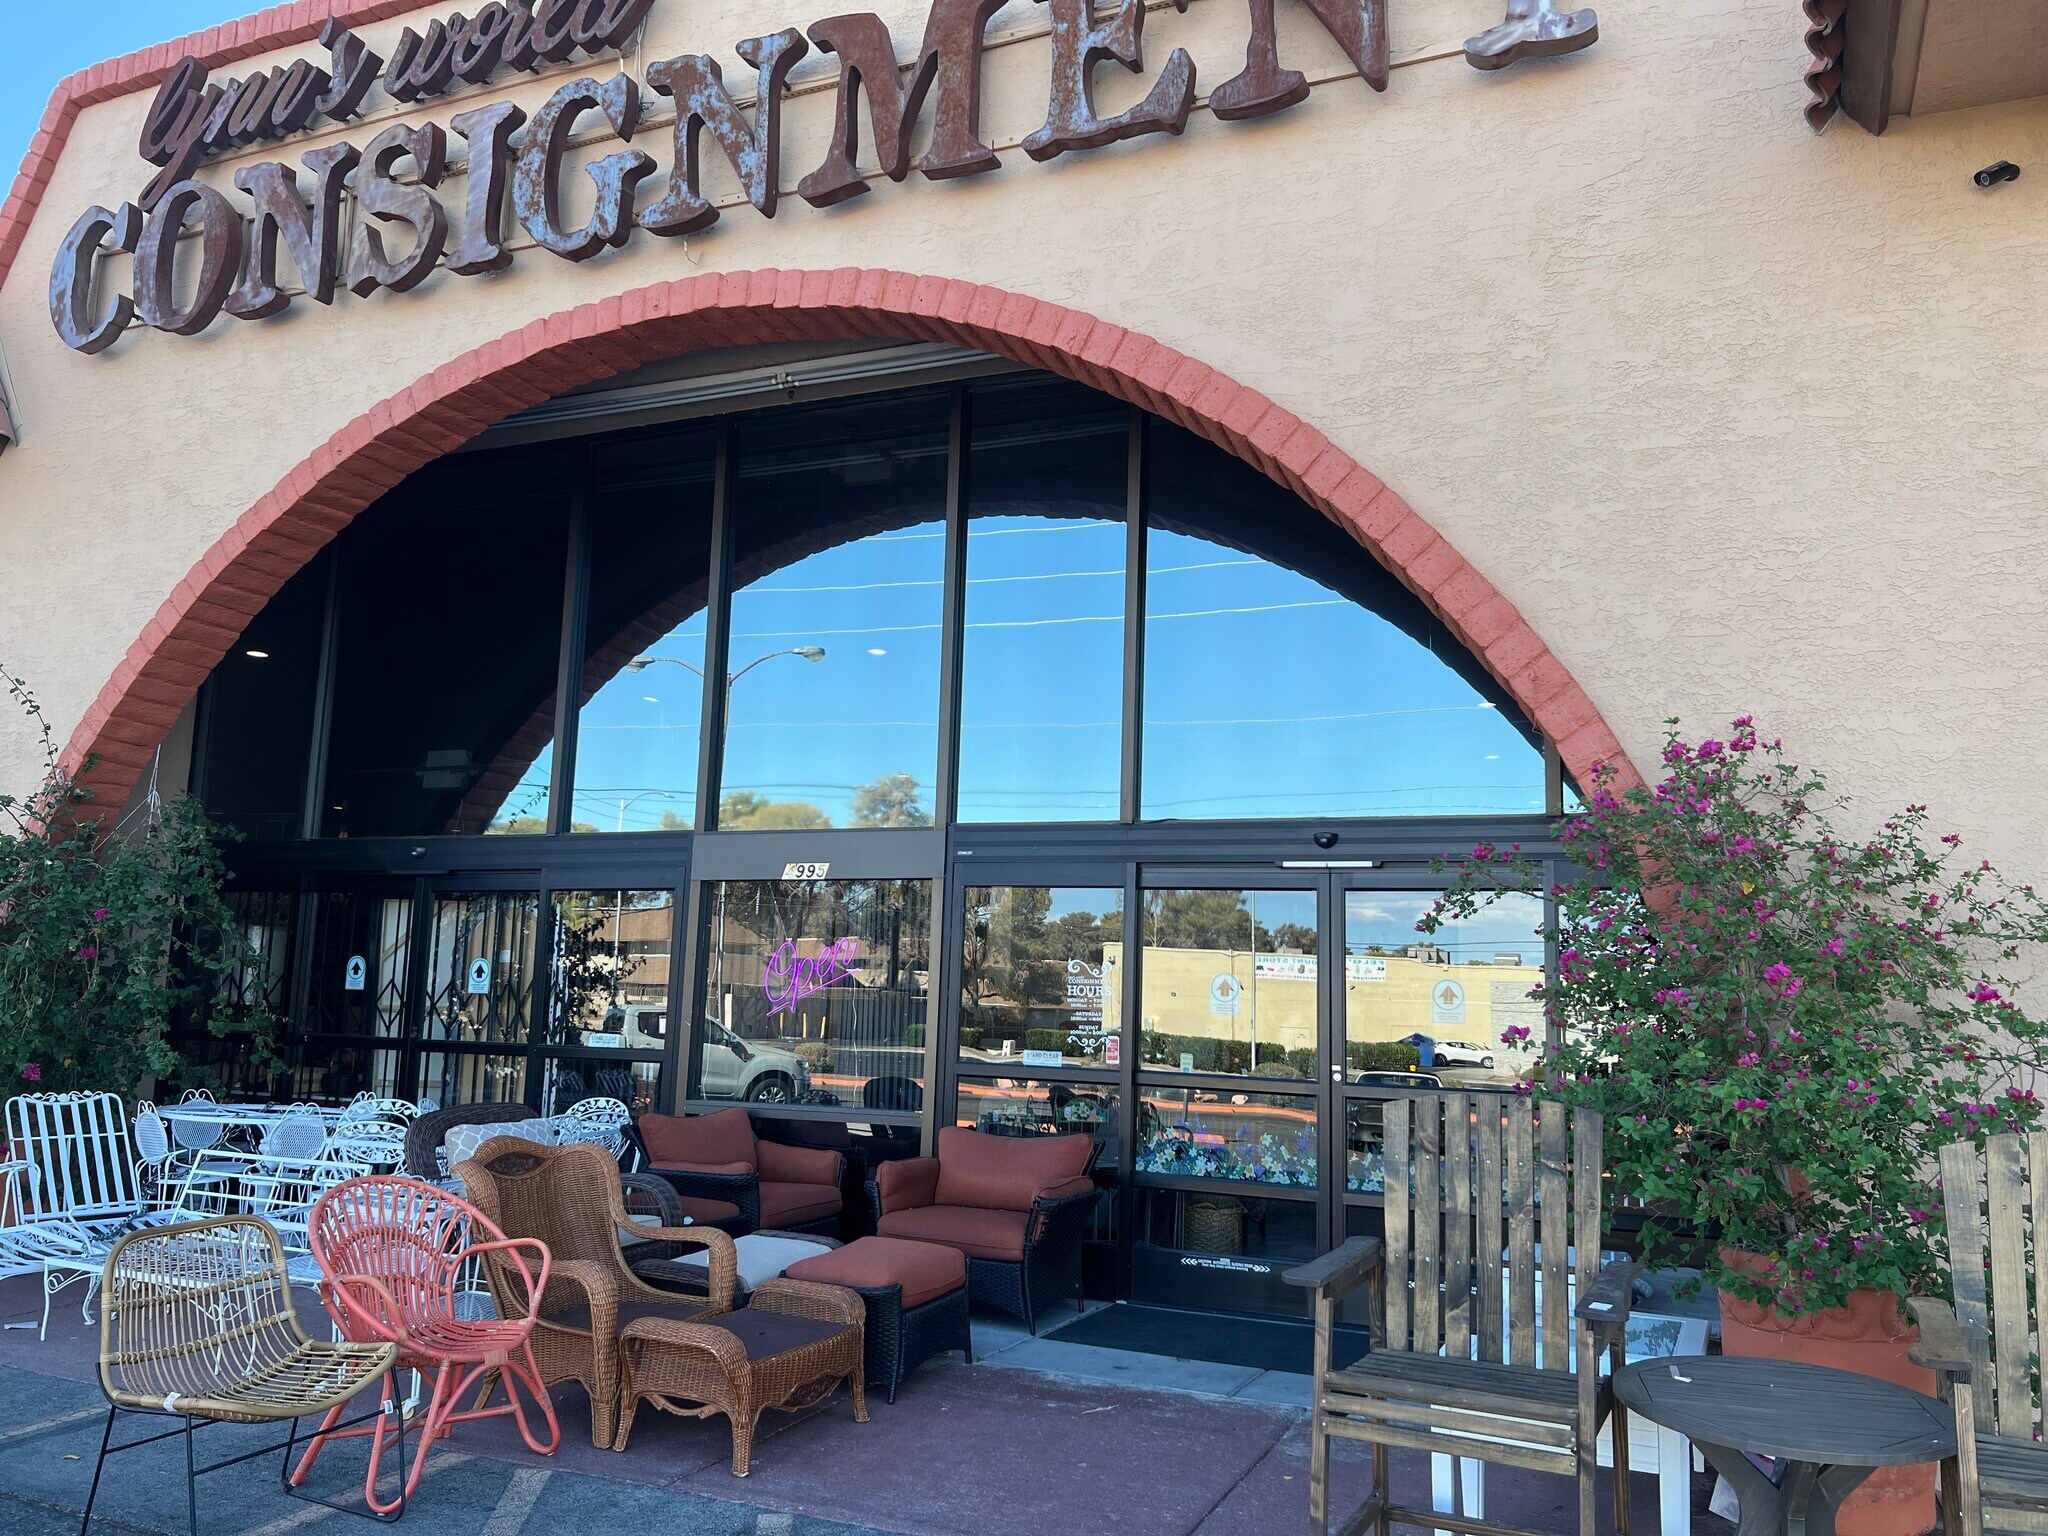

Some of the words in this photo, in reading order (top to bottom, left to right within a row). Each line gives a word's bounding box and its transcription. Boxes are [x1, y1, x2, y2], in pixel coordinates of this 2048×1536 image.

[49, 0, 1599, 355] CONSIGNME
[765, 937, 859, 1013] Open
[1067, 985, 1112, 996] HOURS
